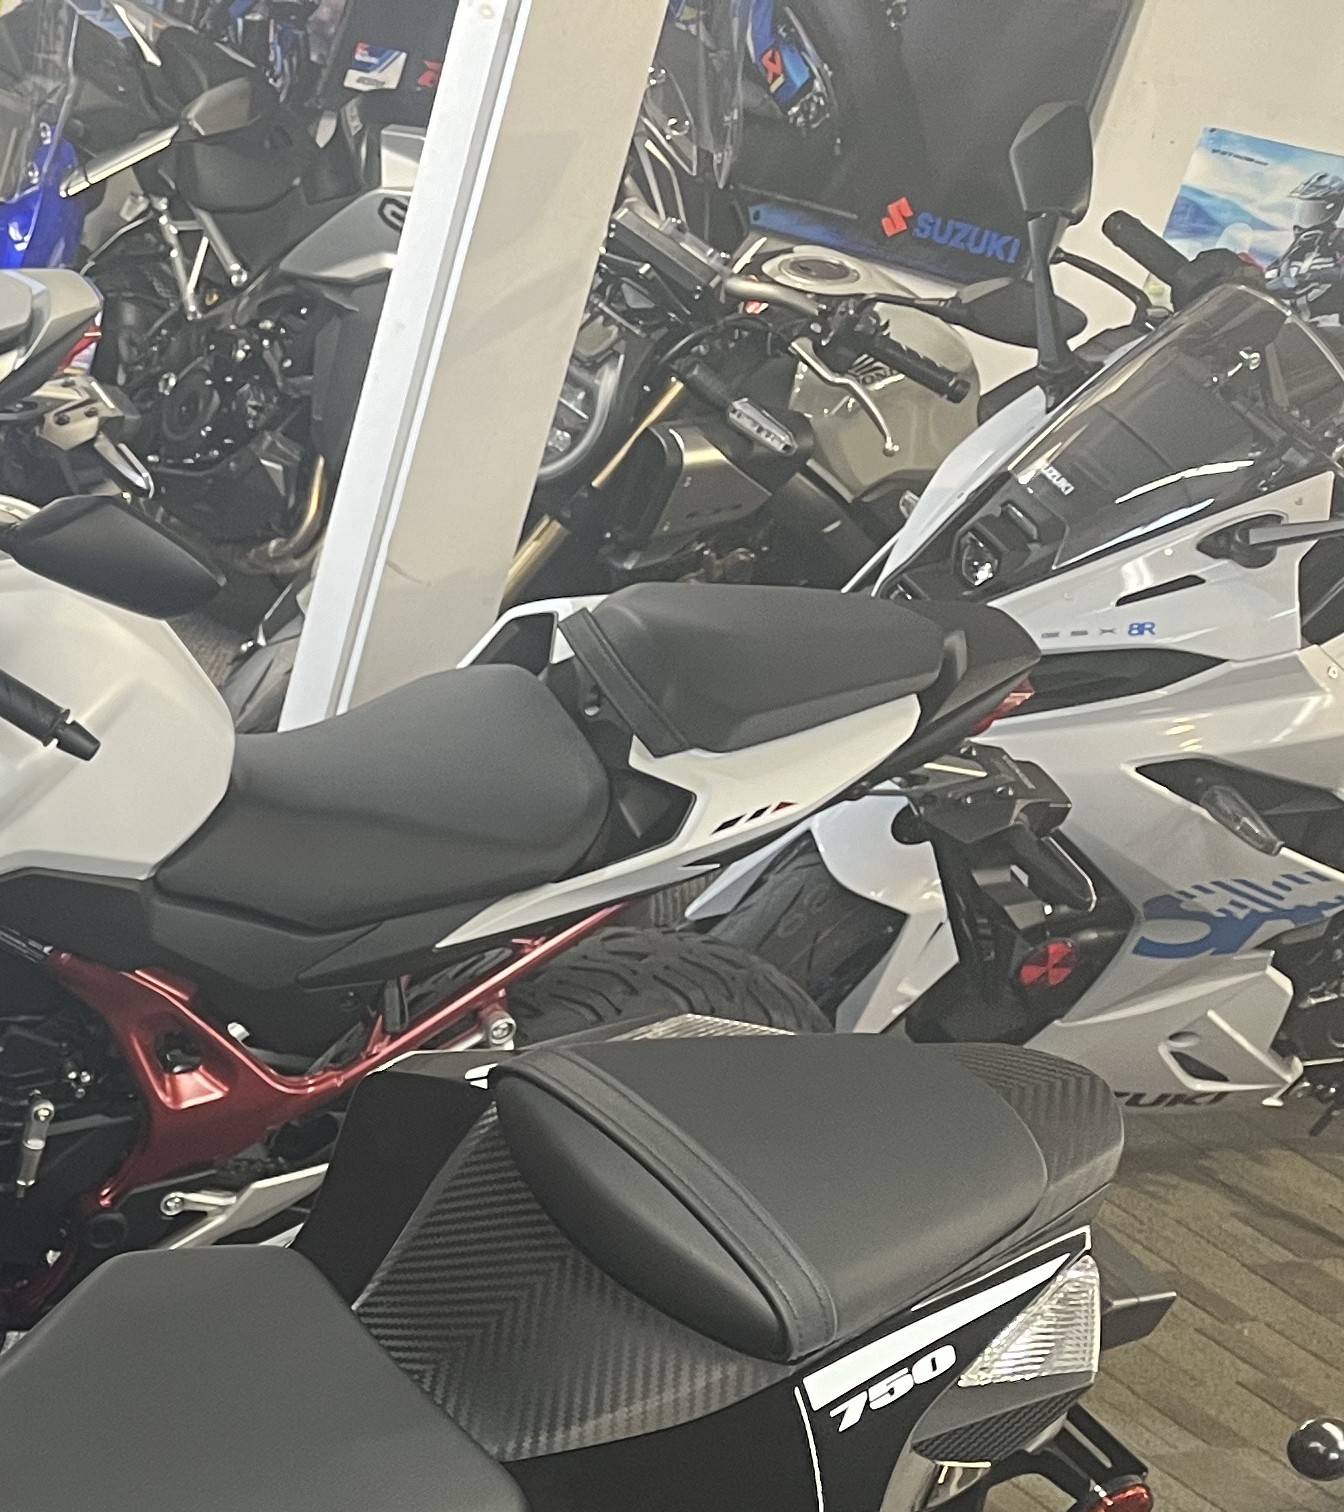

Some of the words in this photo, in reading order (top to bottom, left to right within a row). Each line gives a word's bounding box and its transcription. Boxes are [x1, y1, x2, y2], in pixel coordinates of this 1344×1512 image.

[914, 211, 1021, 264] SUZUKI
[1041, 465, 1075, 495] UZUKI
[1128, 622, 1156, 636] 8R
[829, 1344, 957, 1433] 750
